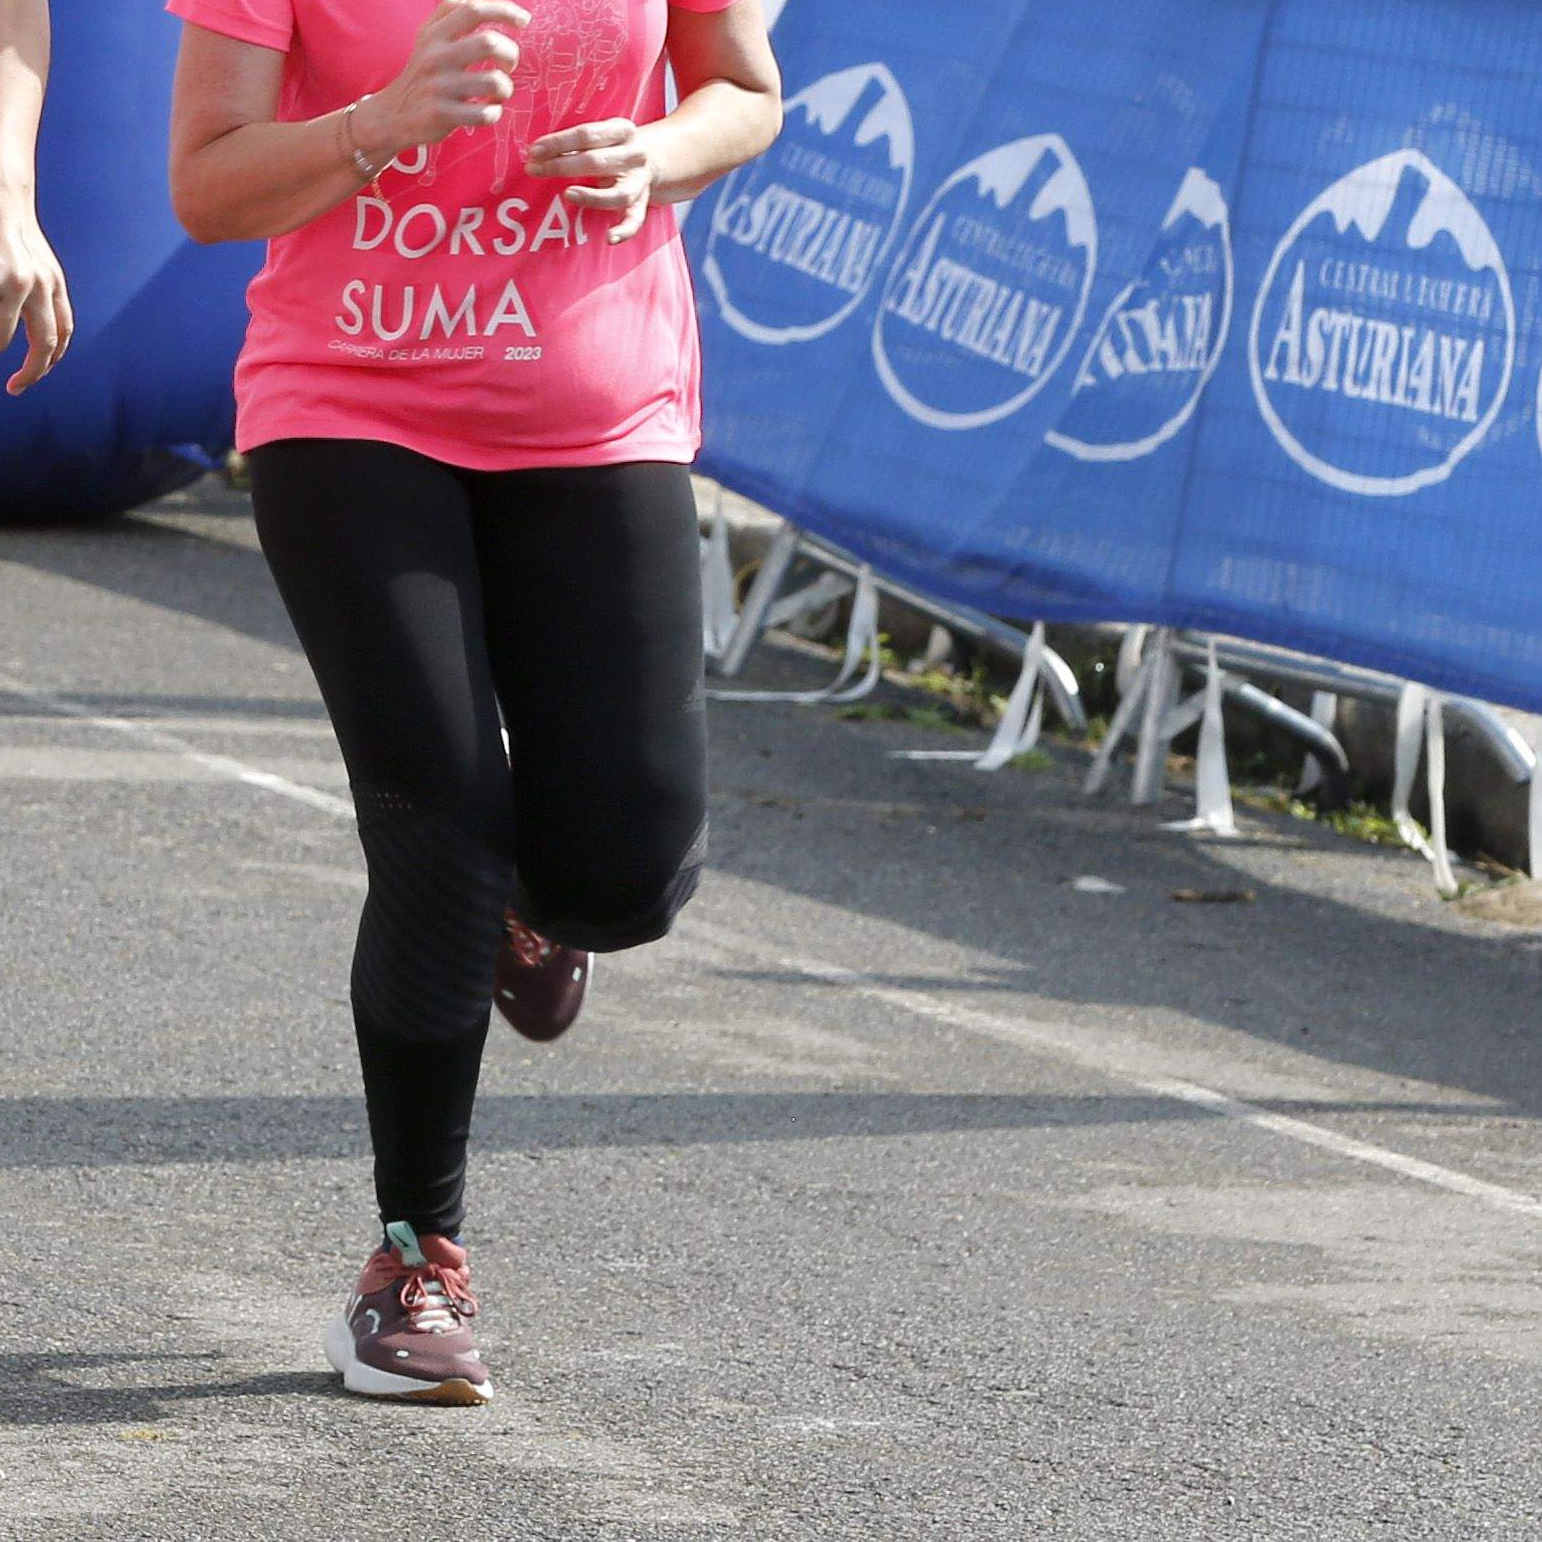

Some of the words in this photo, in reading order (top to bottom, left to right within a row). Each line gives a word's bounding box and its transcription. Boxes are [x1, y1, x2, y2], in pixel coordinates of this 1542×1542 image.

[334, 278, 539, 342] SUMA
[885, 211, 1063, 378] ASTURIANA
[1265, 258, 1484, 424] ASTURIANA
[388, 348, 409, 361] DE
[411, 347, 430, 360] LA
[433, 346, 485, 360] MUJER
[503, 346, 543, 361] 2023
